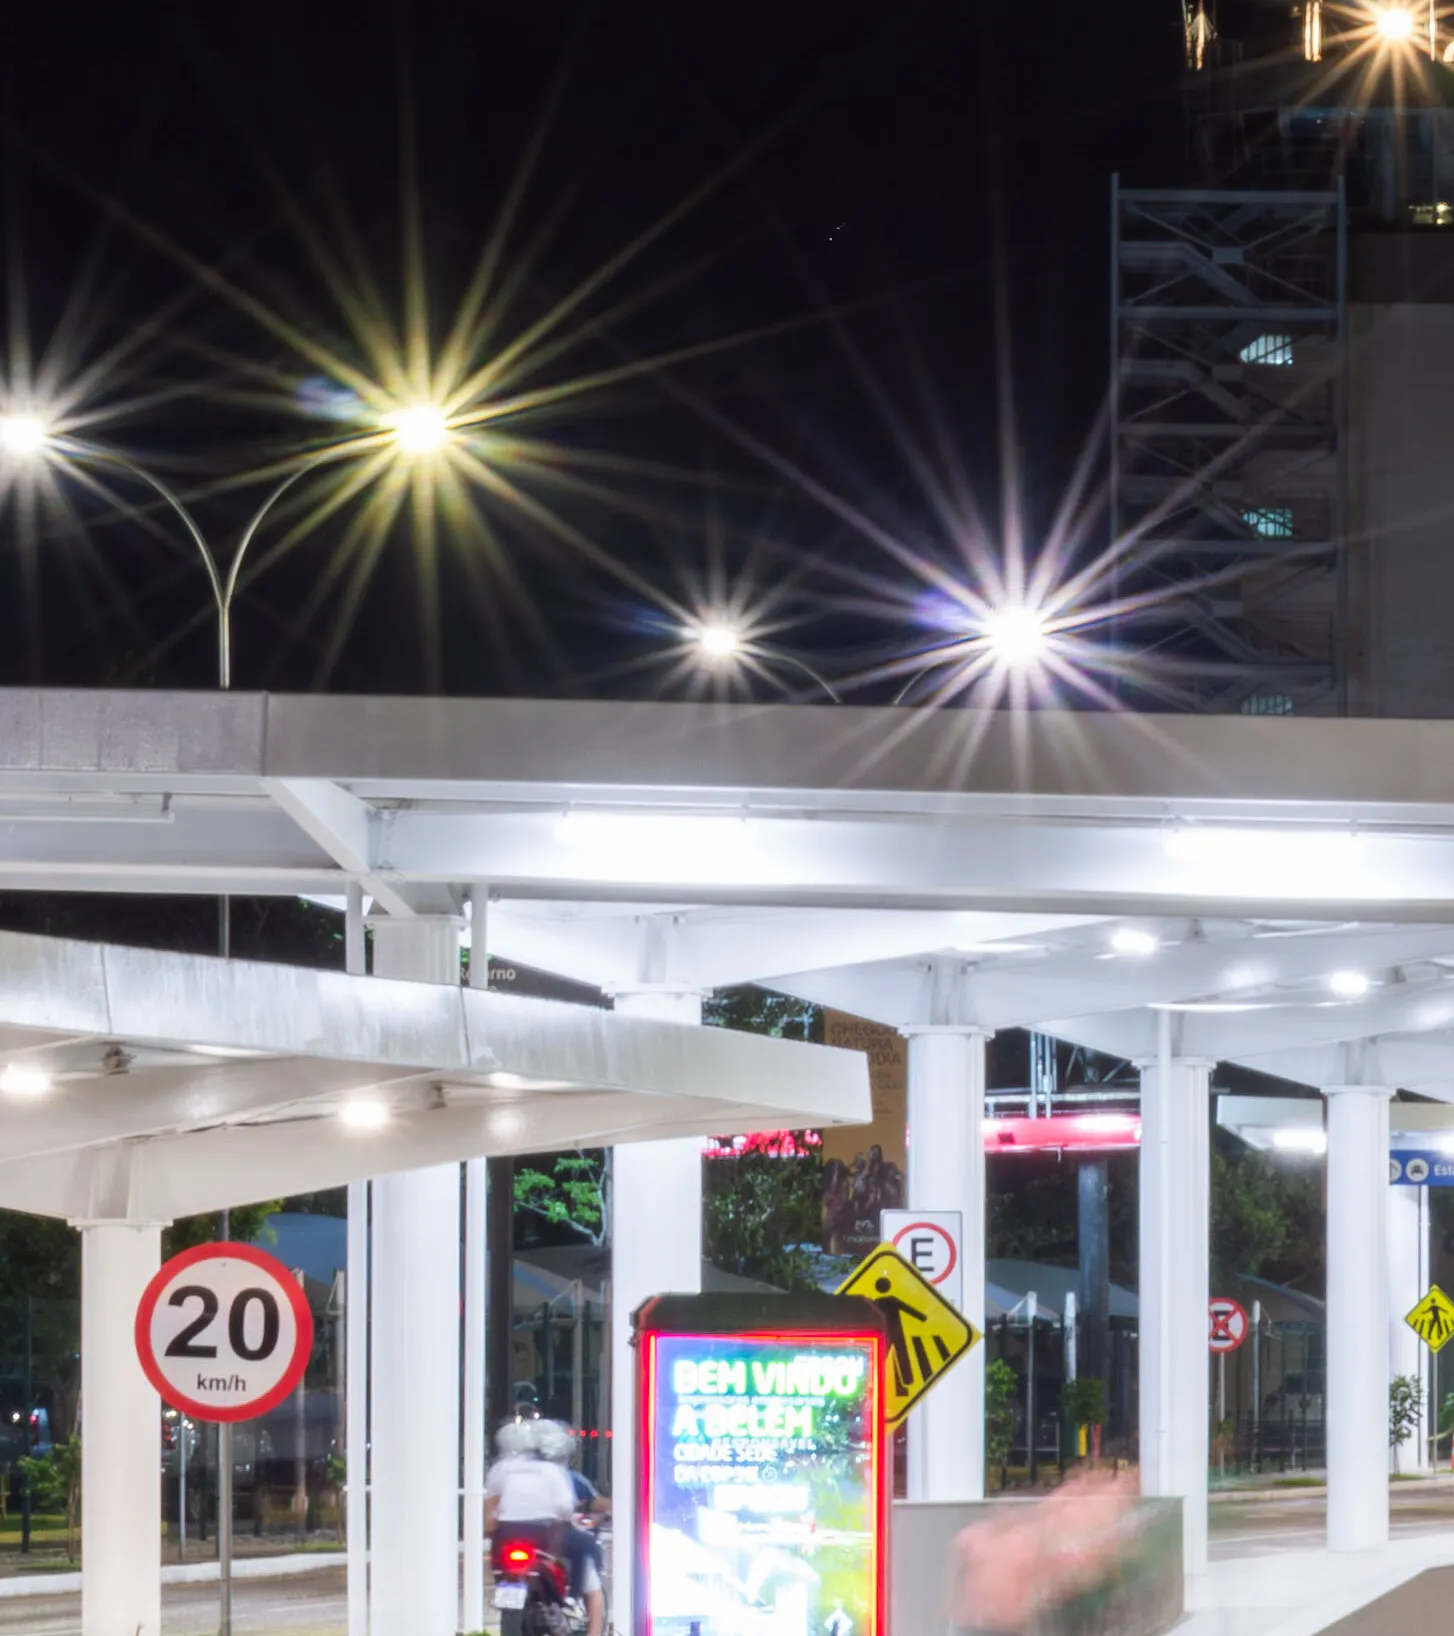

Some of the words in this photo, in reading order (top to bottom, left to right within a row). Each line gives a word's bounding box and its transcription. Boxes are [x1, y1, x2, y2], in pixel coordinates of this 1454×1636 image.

[911, 1237, 935, 1272] E
[165, 1285, 280, 1362] 20
[197, 1373, 247, 1391] km/h
[673, 1360, 747, 1394] BEM
